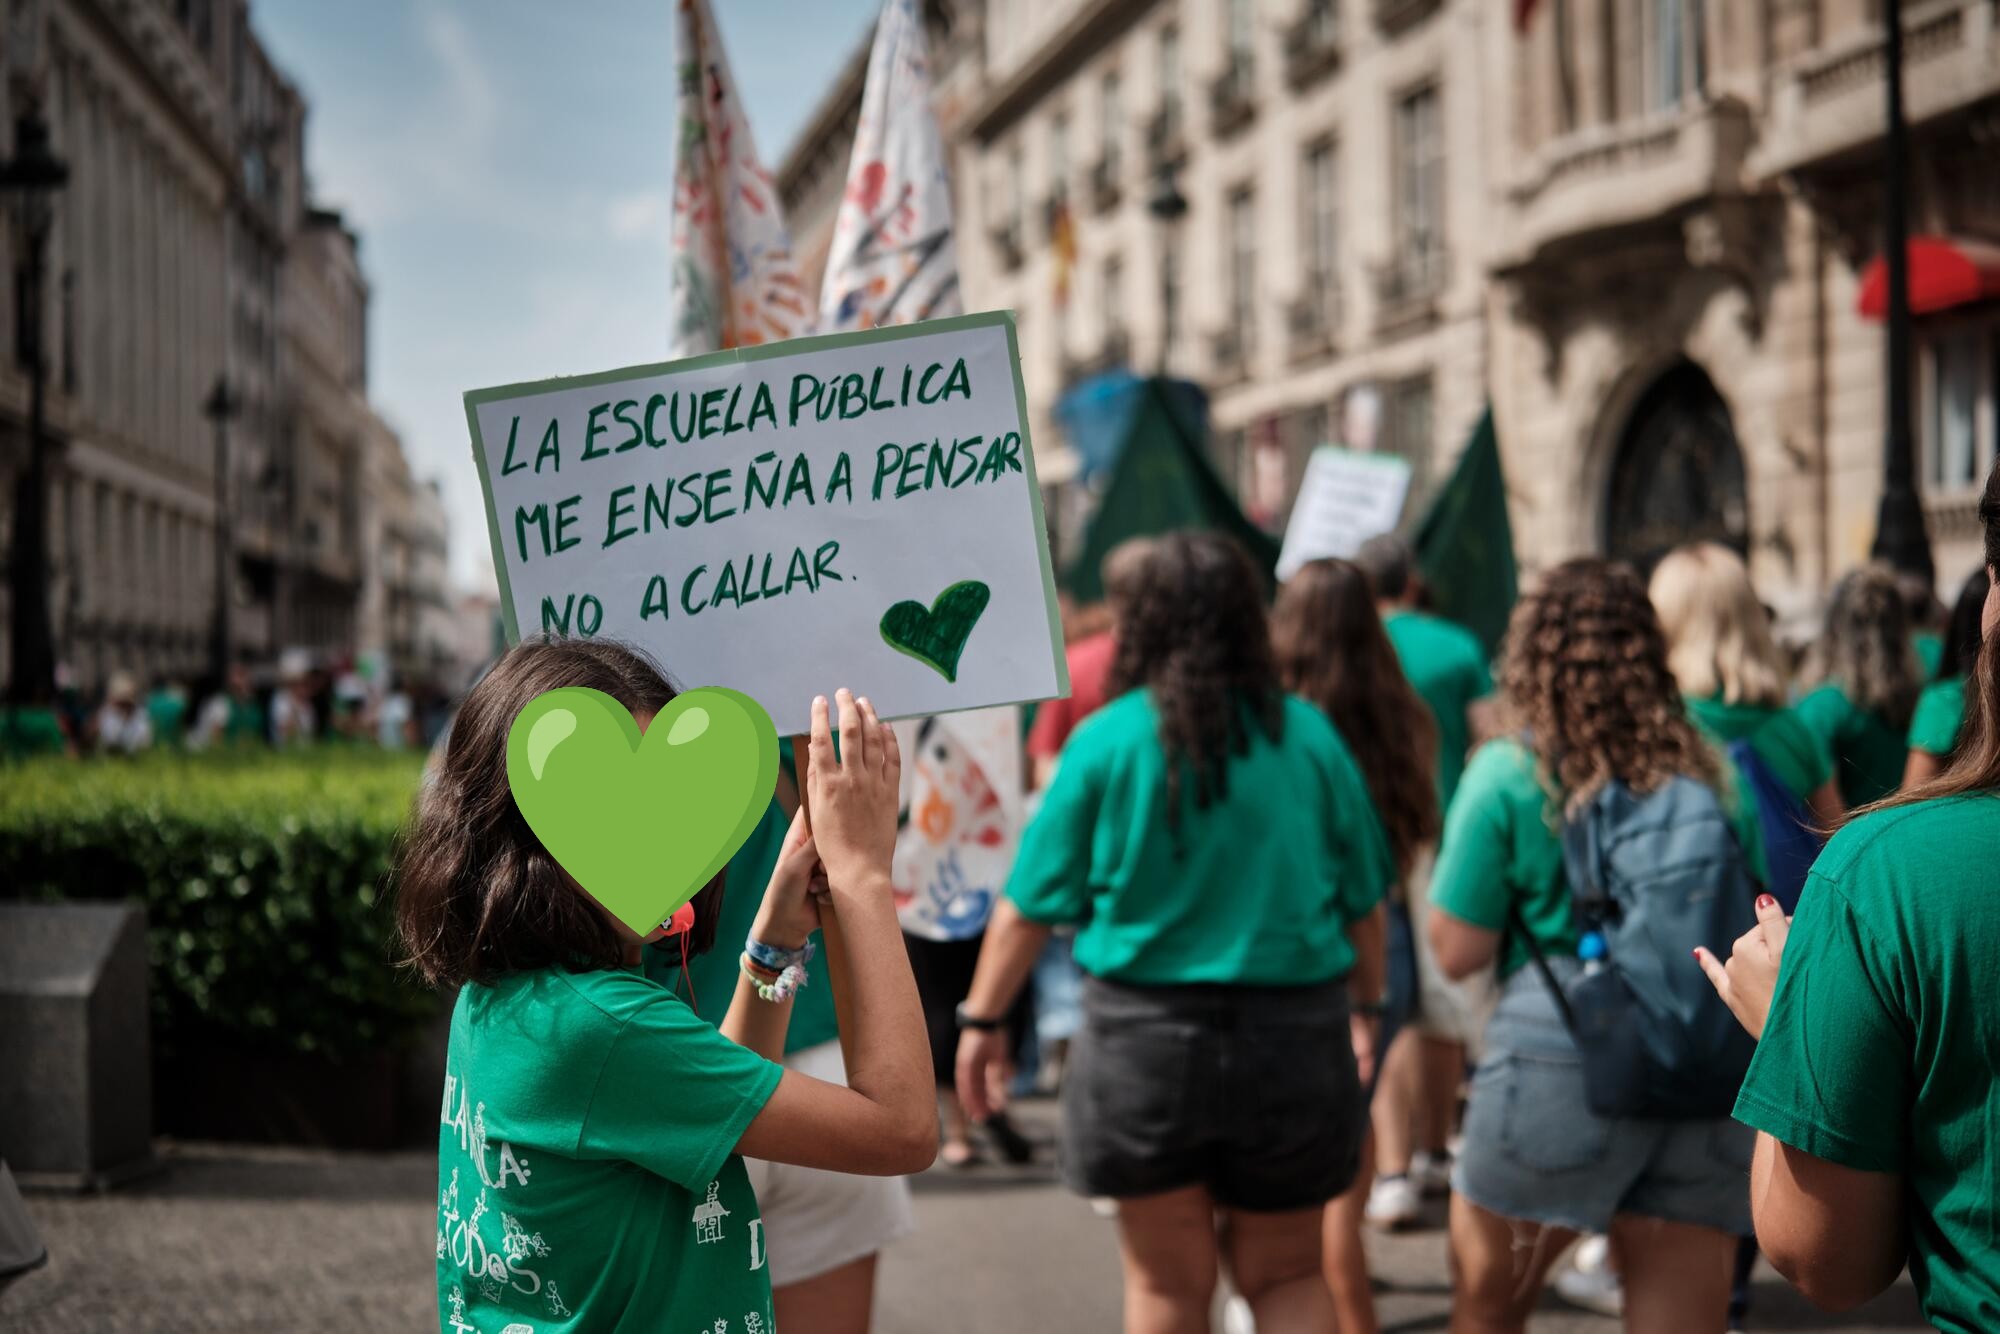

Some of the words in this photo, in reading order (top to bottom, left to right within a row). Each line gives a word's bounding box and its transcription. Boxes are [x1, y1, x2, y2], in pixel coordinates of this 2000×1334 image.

[502, 416, 561, 477] LA
[582, 382, 777, 461] ESCUELA
[789, 358, 971, 427] PÚBLICA
[515, 495, 583, 562] ME
[602, 451, 815, 549] ENSEÑA
[826, 453, 853, 503] A
[871, 432, 1023, 501] PENSAR
[541, 594, 604, 644] NO
[640, 575, 669, 621] A
[681, 541, 857, 616] CALLAR.
